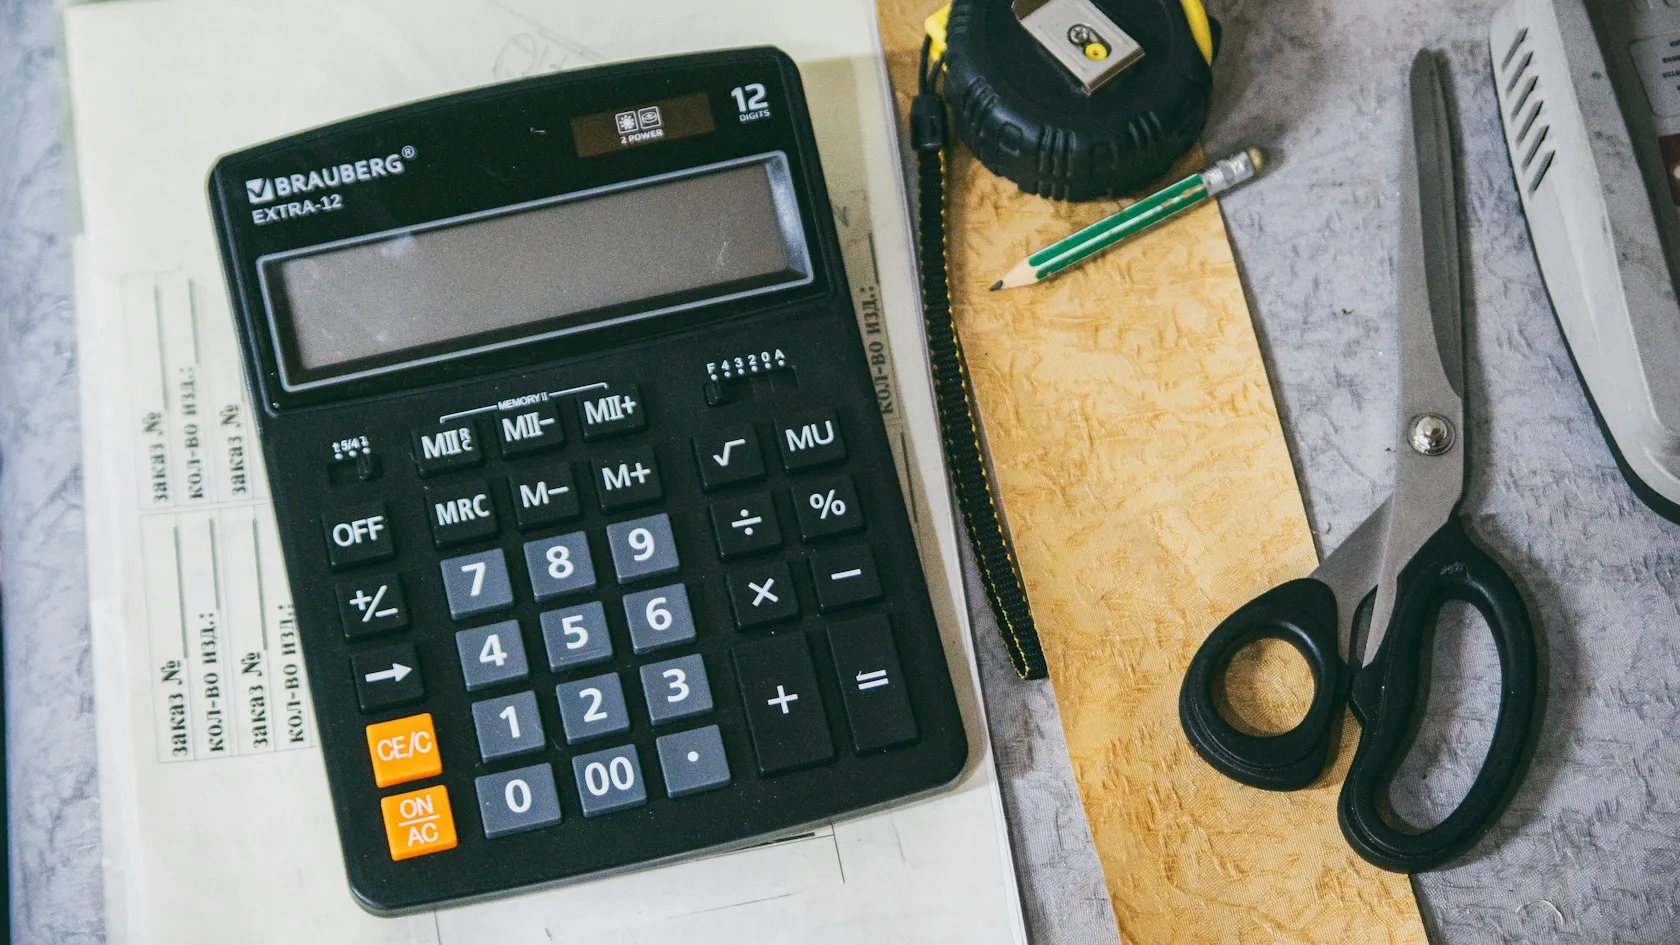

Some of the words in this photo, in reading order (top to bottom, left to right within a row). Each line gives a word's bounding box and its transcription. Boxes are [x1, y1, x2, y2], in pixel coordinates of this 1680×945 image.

[731, 83, 769, 113] 12
[739, 108, 770, 122] DIGITS
[620, 136, 628, 145] 2
[628, 128, 664, 143] POWER
[252, 193, 342, 225] EXTRA-12
[706, 362, 716, 374] F
[721, 360, 730, 370] 4
[734, 357, 744, 368] 3
[747, 354, 757, 366] 2
[774, 348, 786, 360] A
[219, 404, 241, 428] №
[498, 393, 541, 410] MEMORY
[141, 411, 163, 435] №
[786, 421, 834, 451] MU
[149, 443, 168, 503] заказ
[184, 423, 203, 499] кол-во
[227, 436, 246, 496] заказ
[602, 463, 650, 490] M+
[435, 494, 490, 525] MRC
[810, 490, 845, 519] %
[333, 516, 383, 546] OFF
[629, 529, 654, 560] 9
[547, 546, 573, 578] 8
[462, 562, 485, 595] 7
[646, 598, 671, 630] 6
[199, 612, 217, 664] изд.:
[562, 614, 588, 649] 5
[240, 652, 262, 677] №
[480, 635, 507, 665] 4
[160, 659, 182, 685] №
[663, 669, 689, 702] 3
[203, 672, 224, 752] кол-во
[248, 684, 268, 748] заказ
[283, 663, 304, 743] кол-во
[580, 688, 607, 722] 2
[168, 692, 188, 757] заказ
[499, 706, 521, 738] 1
[377, 731, 432, 761] CE/C
[585, 757, 633, 795] 00
[400, 795, 434, 819] ON
[505, 780, 531, 812] 0
[407, 823, 439, 847] AC
